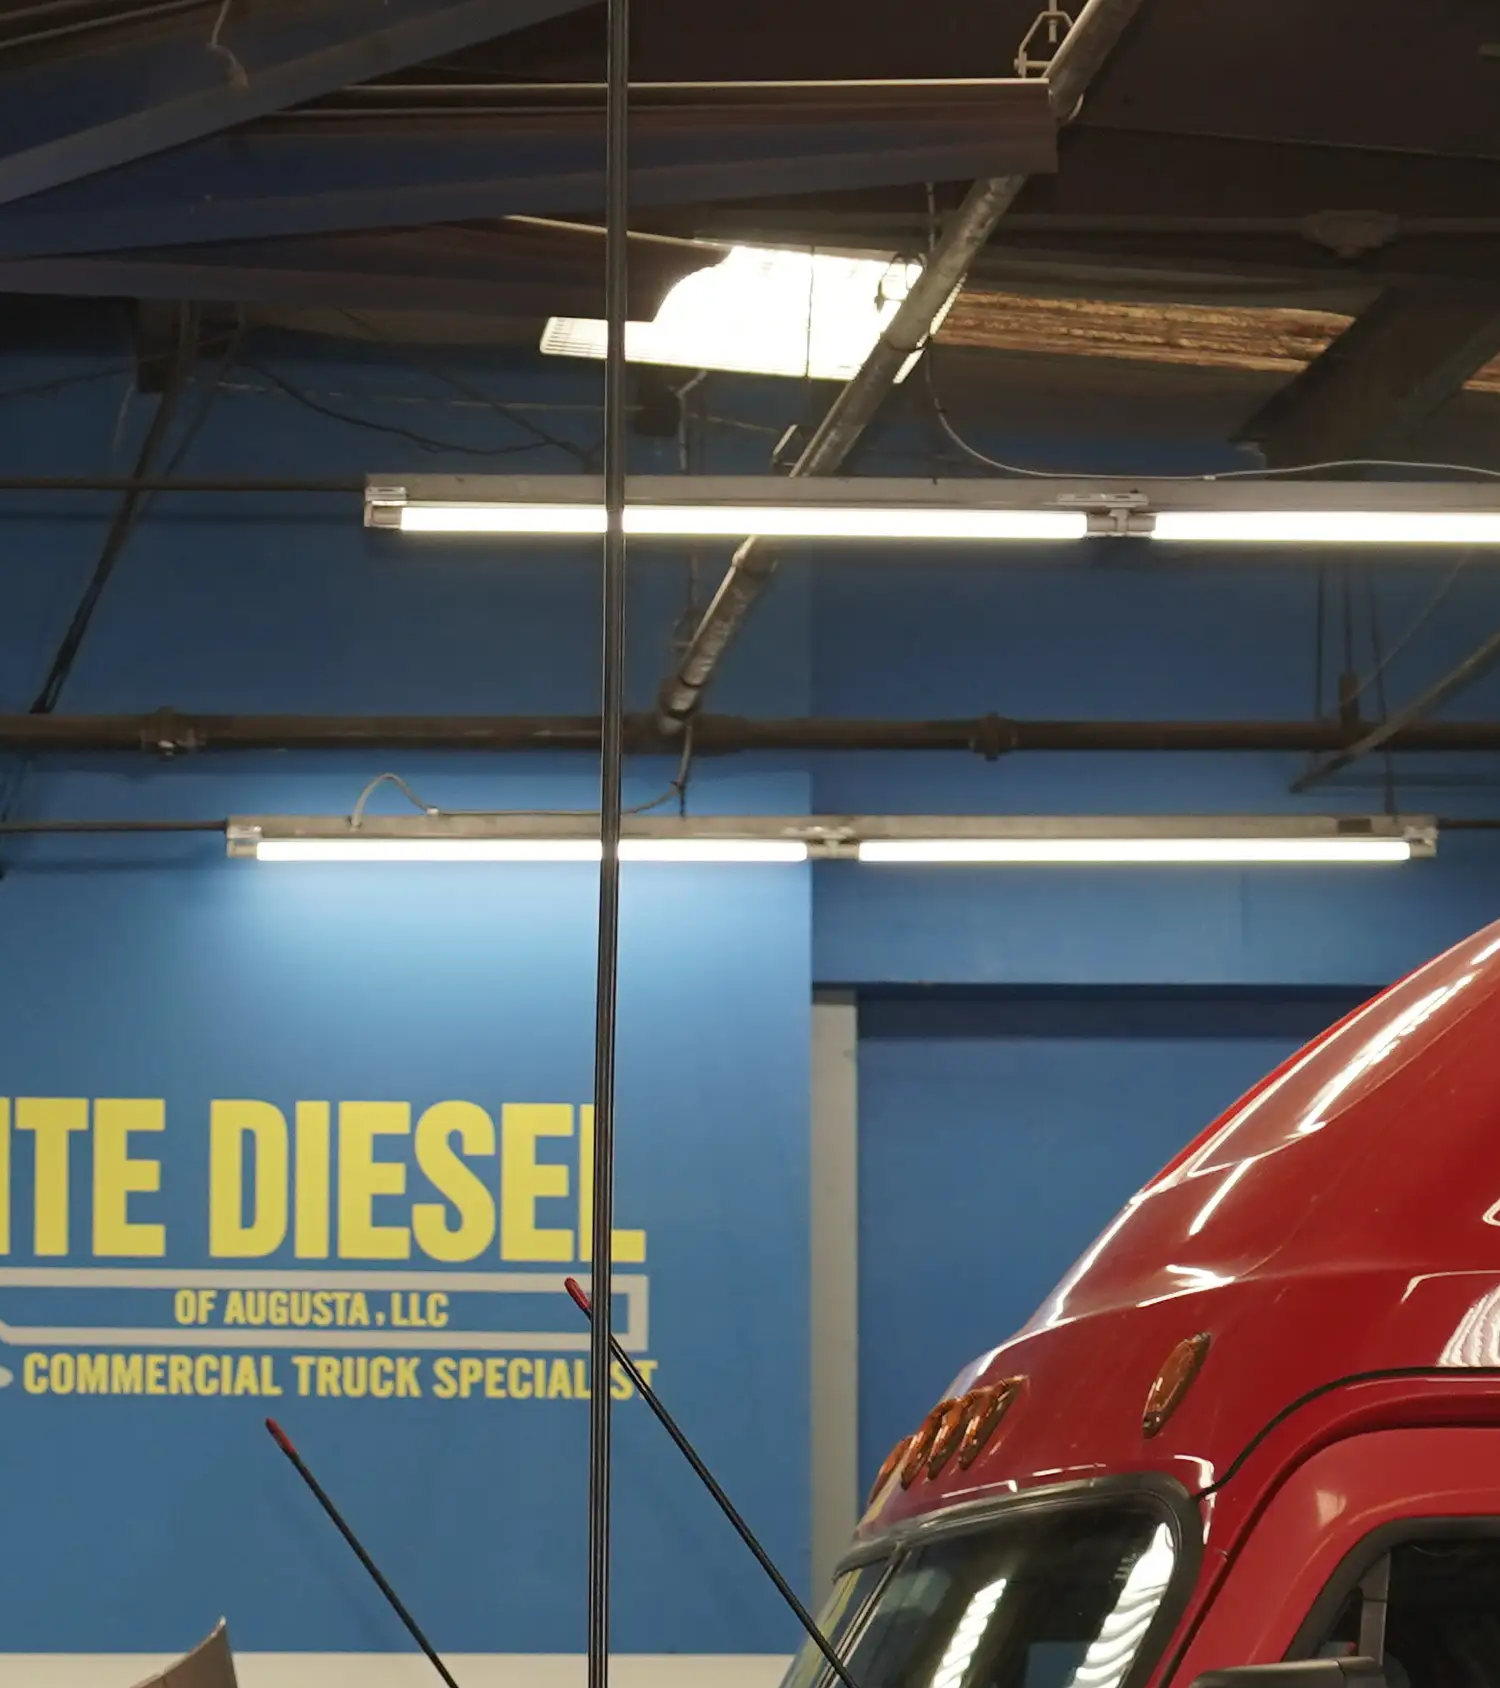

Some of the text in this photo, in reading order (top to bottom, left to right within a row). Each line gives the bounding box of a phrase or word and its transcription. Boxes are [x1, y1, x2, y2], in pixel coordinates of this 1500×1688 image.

[209, 1100, 646, 1262] DIESEL
[174, 1291, 219, 1325] OF
[390, 1292, 449, 1328] LLC
[23, 1352, 658, 1402] COMMERCIAL TRUCK SPECIALST
